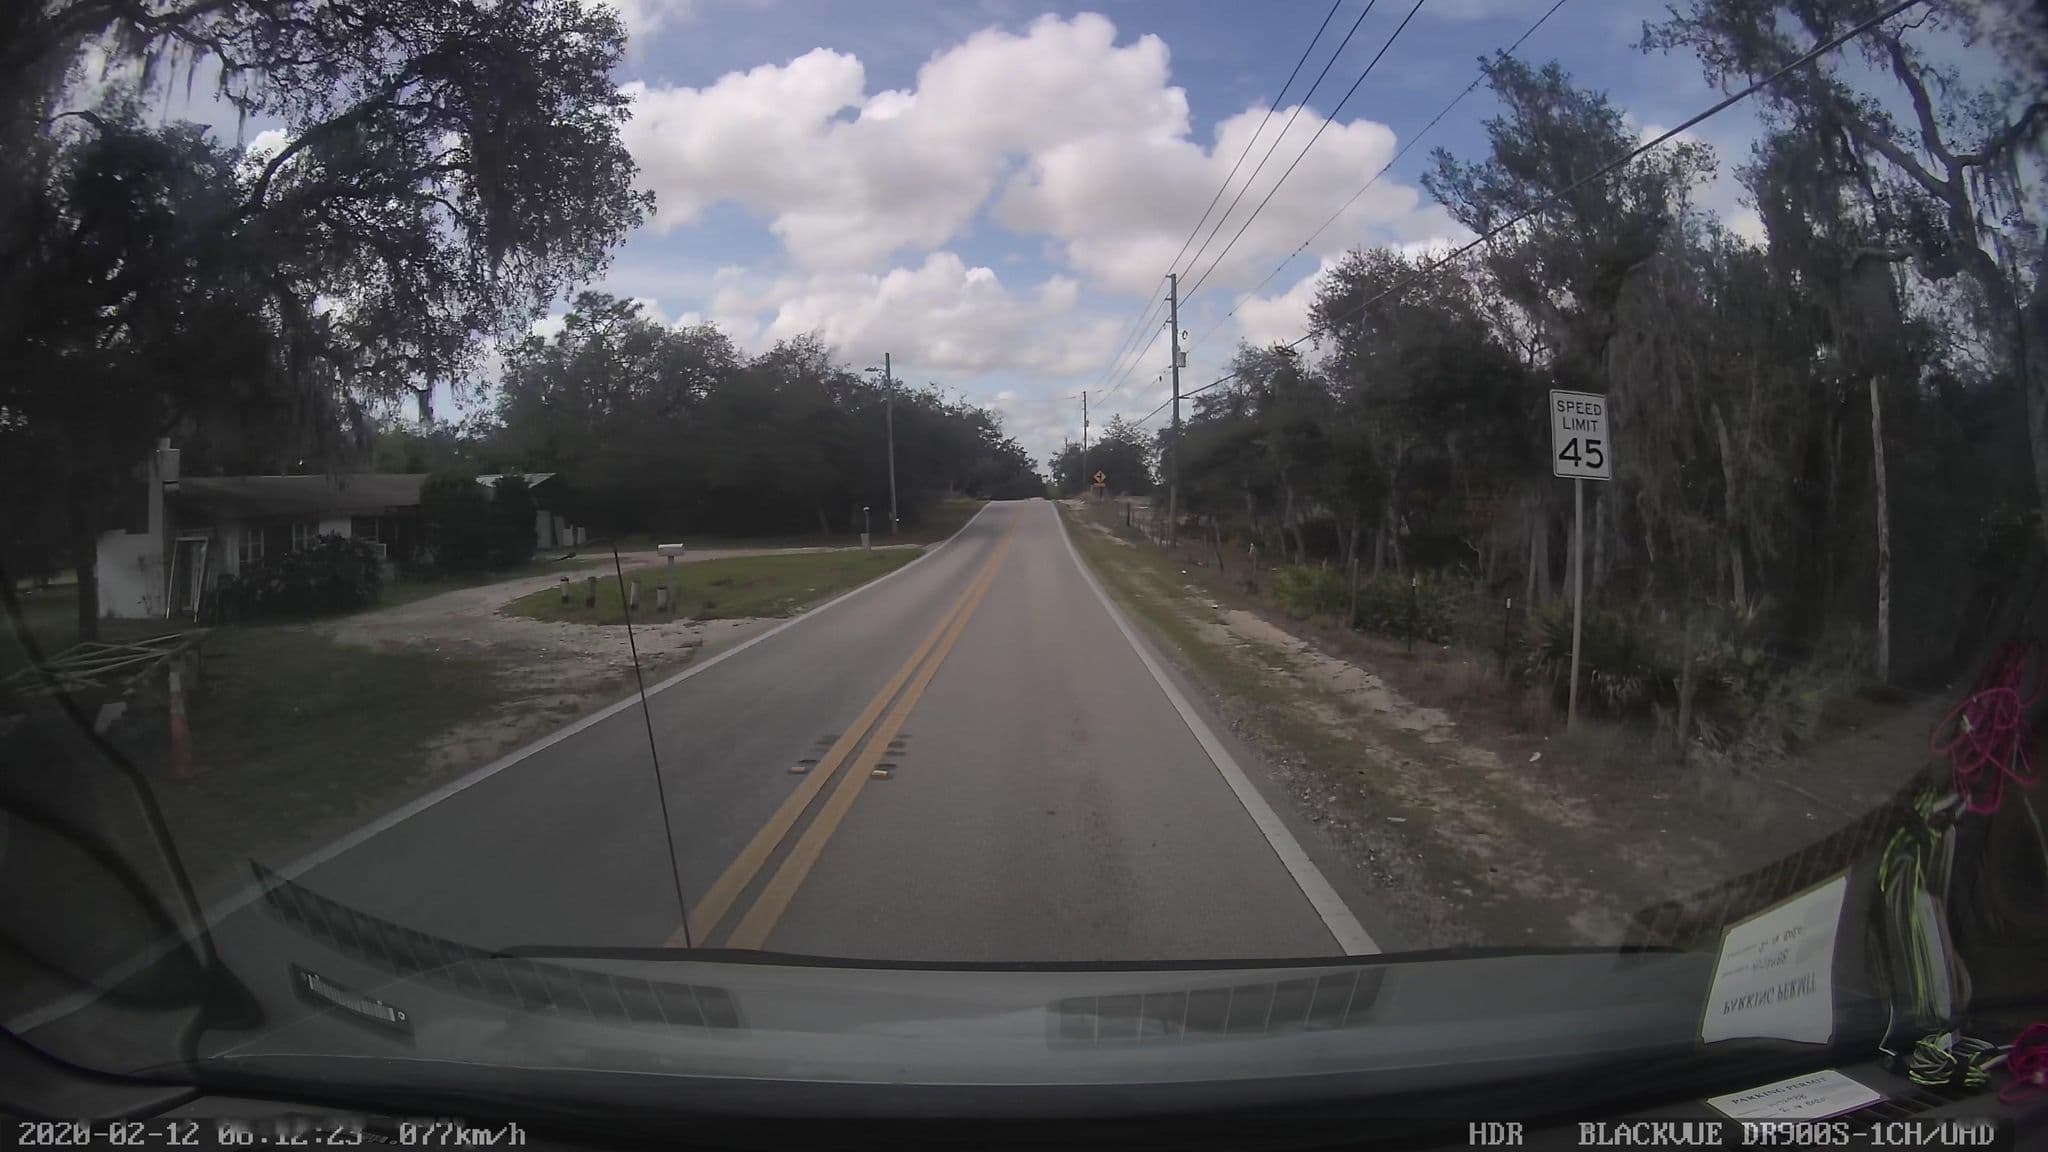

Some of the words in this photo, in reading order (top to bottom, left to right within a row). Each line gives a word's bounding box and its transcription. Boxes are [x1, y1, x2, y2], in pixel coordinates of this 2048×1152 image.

[1557, 400, 1602, 416] SPEED
[1562, 416, 1598, 432] LIMIT
[1558, 437, 1604, 469] 45
[1731, 1086, 1786, 1105] PARKING
[1787, 1077, 1828, 1092] PERMIT
